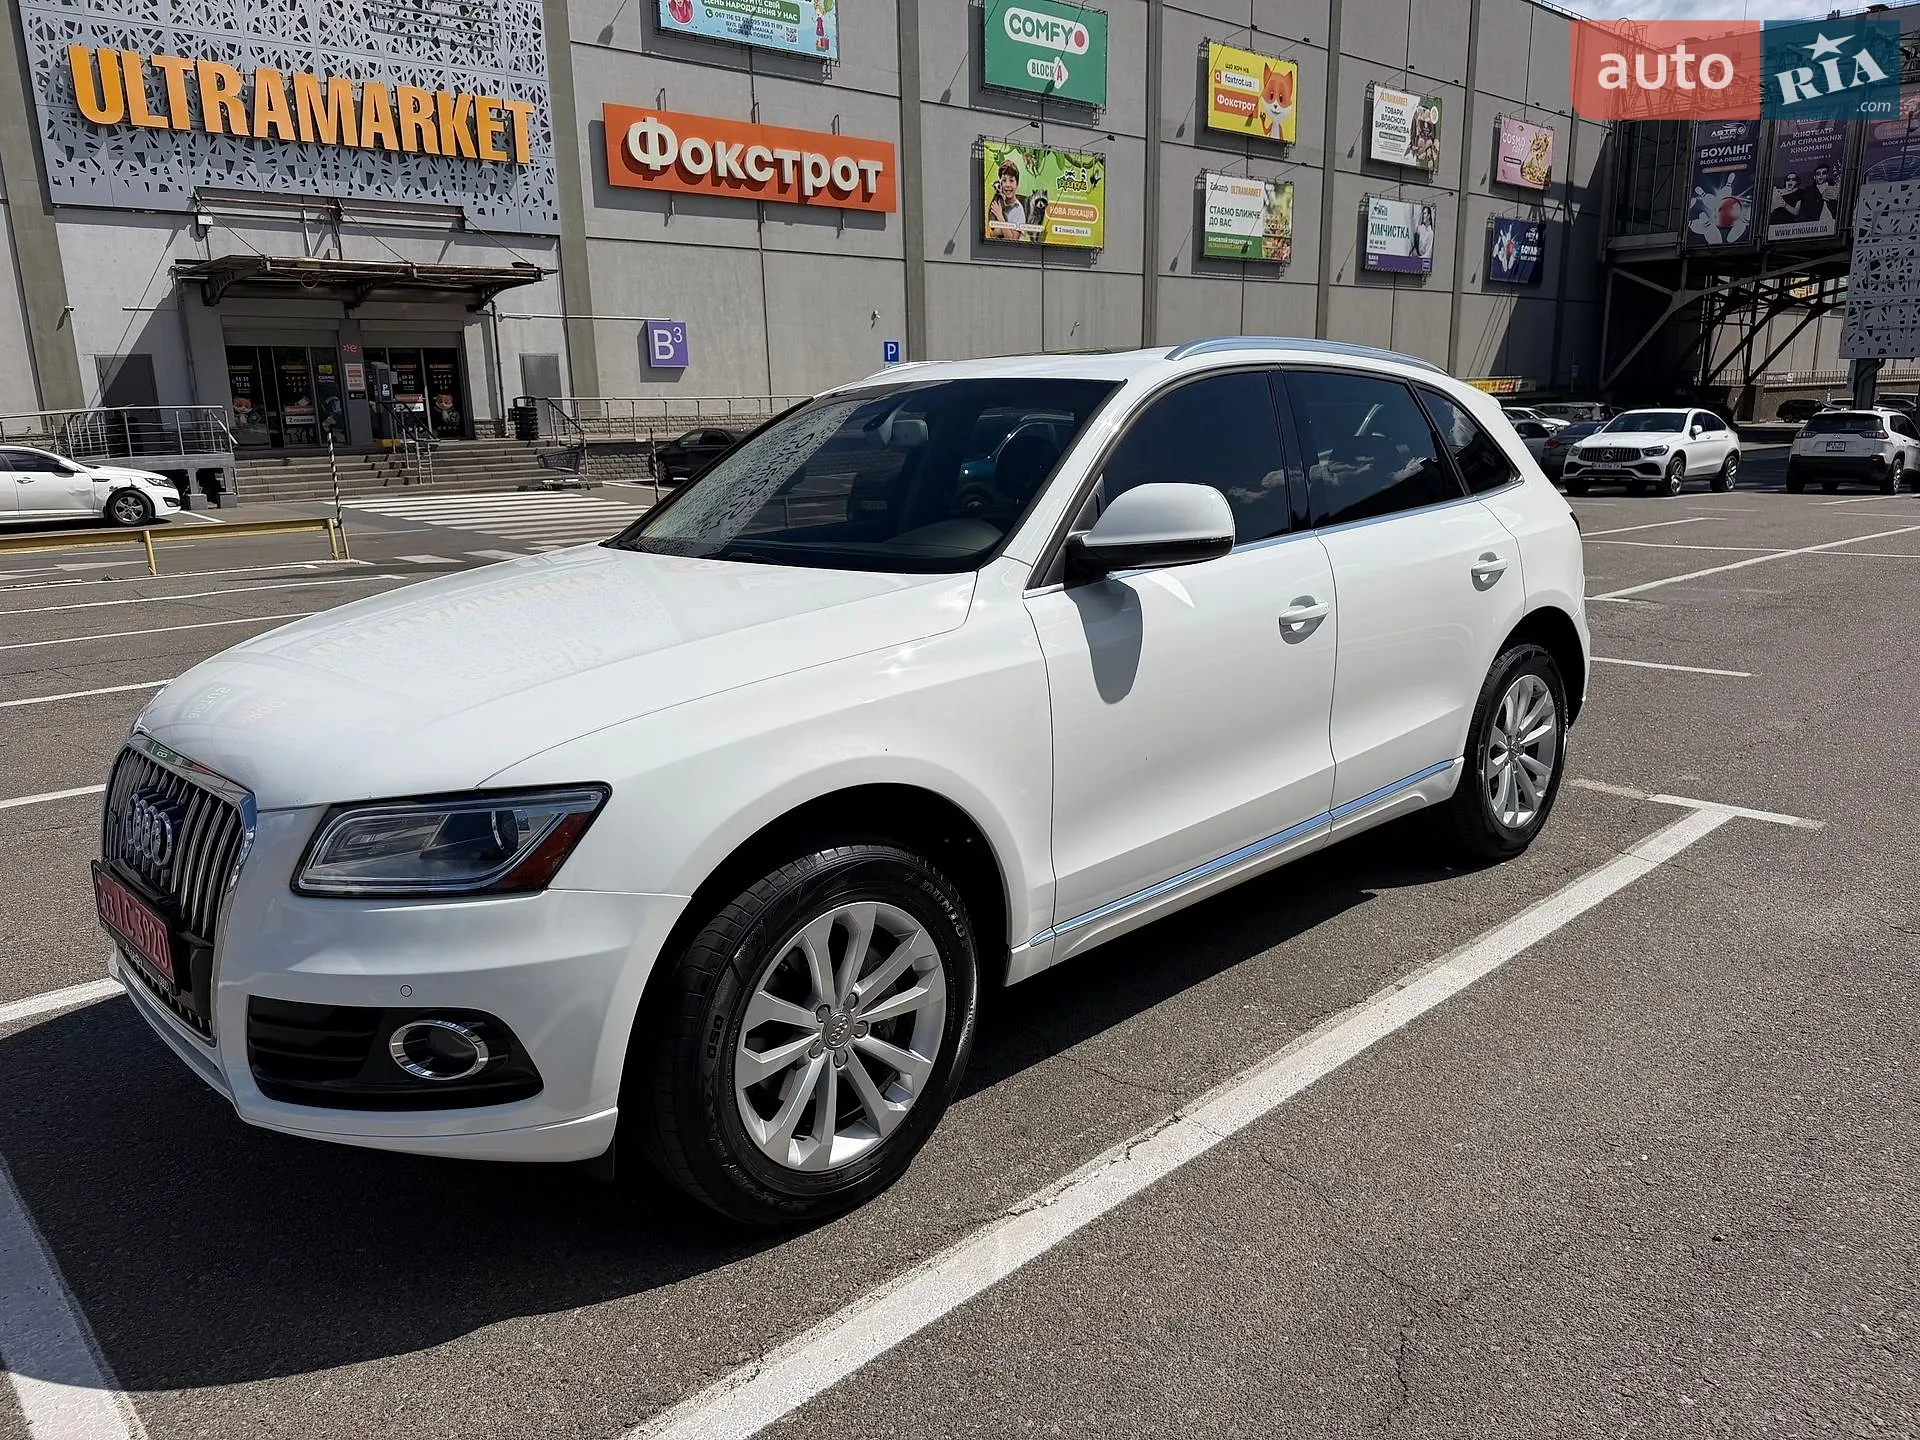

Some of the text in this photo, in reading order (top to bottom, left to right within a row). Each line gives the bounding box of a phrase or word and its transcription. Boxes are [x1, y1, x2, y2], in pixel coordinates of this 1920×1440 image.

[725, 0, 776, 17] НАРОДЖЕННЯ
[783, 11, 798, 21] НАС
[1008, 13, 1073, 46] COMFY
[1031, 62, 1063, 81] BLOCK A
[1224, 73, 1253, 88] foxtrot.ua
[67, 44, 536, 165] ULTRAMARKET
[1216, 94, 1257, 112] Фокстрот
[1792, 127, 1834, 138] КІНОТЕАТР
[1780, 134, 1843, 149] ДЛЯ СПРАВЖНІХ
[1790, 143, 1833, 154] КІНОМАНІВ
[627, 116, 884, 197] Фокстрот
[1701, 143, 1753, 159] БОУЛІНГ
[1209, 205, 1261, 220] СТАЄМО БЛИЖЧЕ
[1208, 217, 1232, 228] ДО ВАС
[1370, 222, 1410, 239] ХІМЧИСТКА
[887, 343, 897, 360] P
